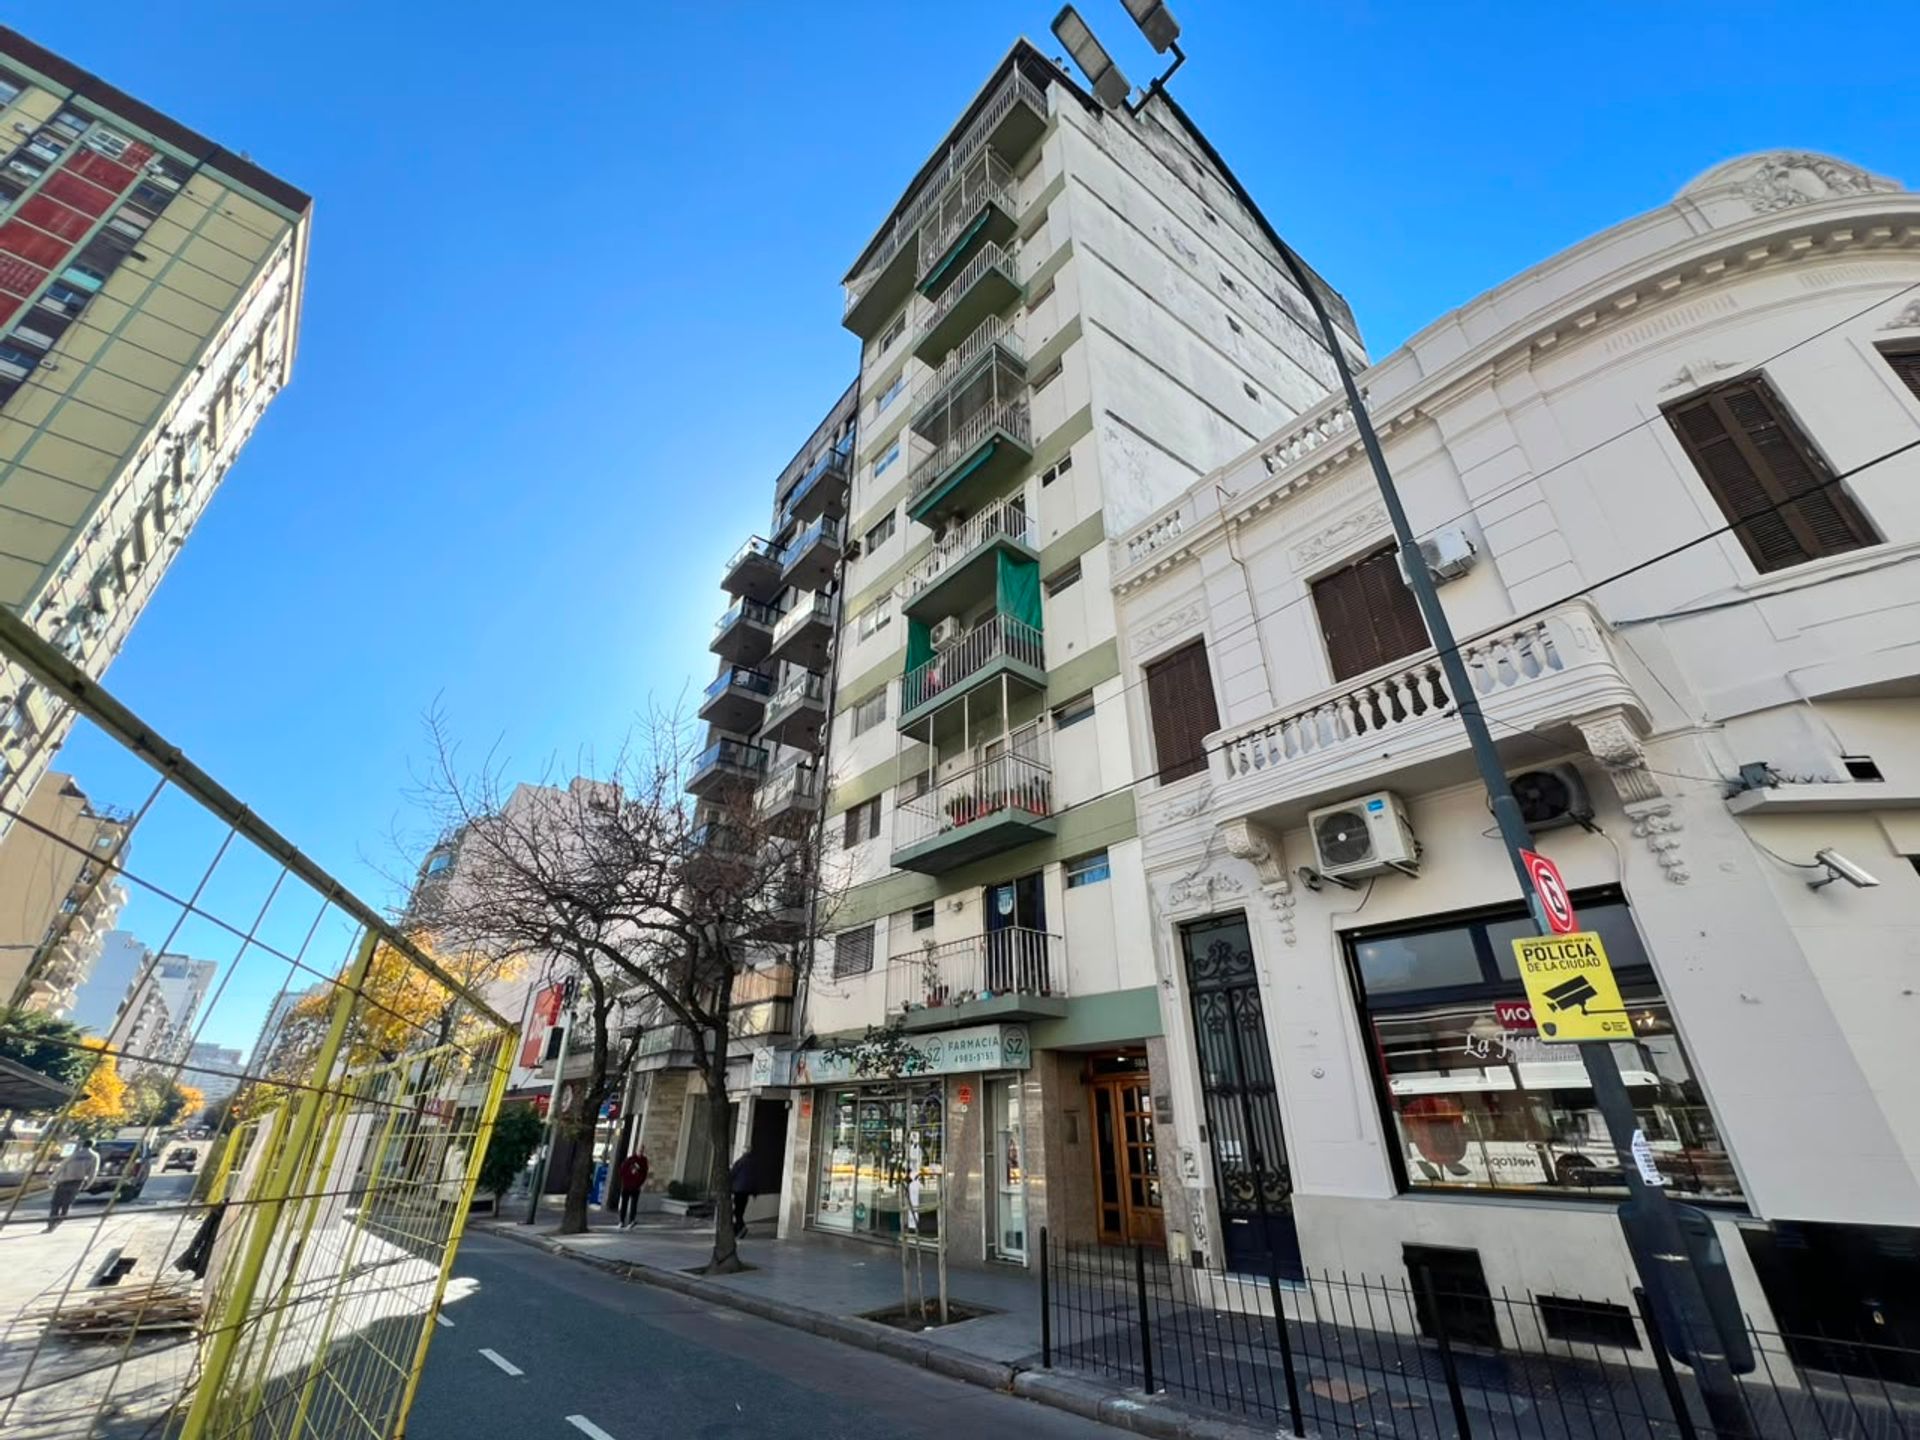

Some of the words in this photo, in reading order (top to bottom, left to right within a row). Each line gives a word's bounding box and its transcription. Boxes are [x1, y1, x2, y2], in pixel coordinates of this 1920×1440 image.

[1523, 943, 1597, 962] POLICIA
[1527, 963, 1542, 973] DE
[1544, 961, 1559, 971] LA
[1559, 958, 1601, 971] CIUDAD
[948, 1036, 999, 1052] FARMACIA
[1006, 1038, 1023, 1055] SZ
[1464, 1033, 1490, 1058] La
